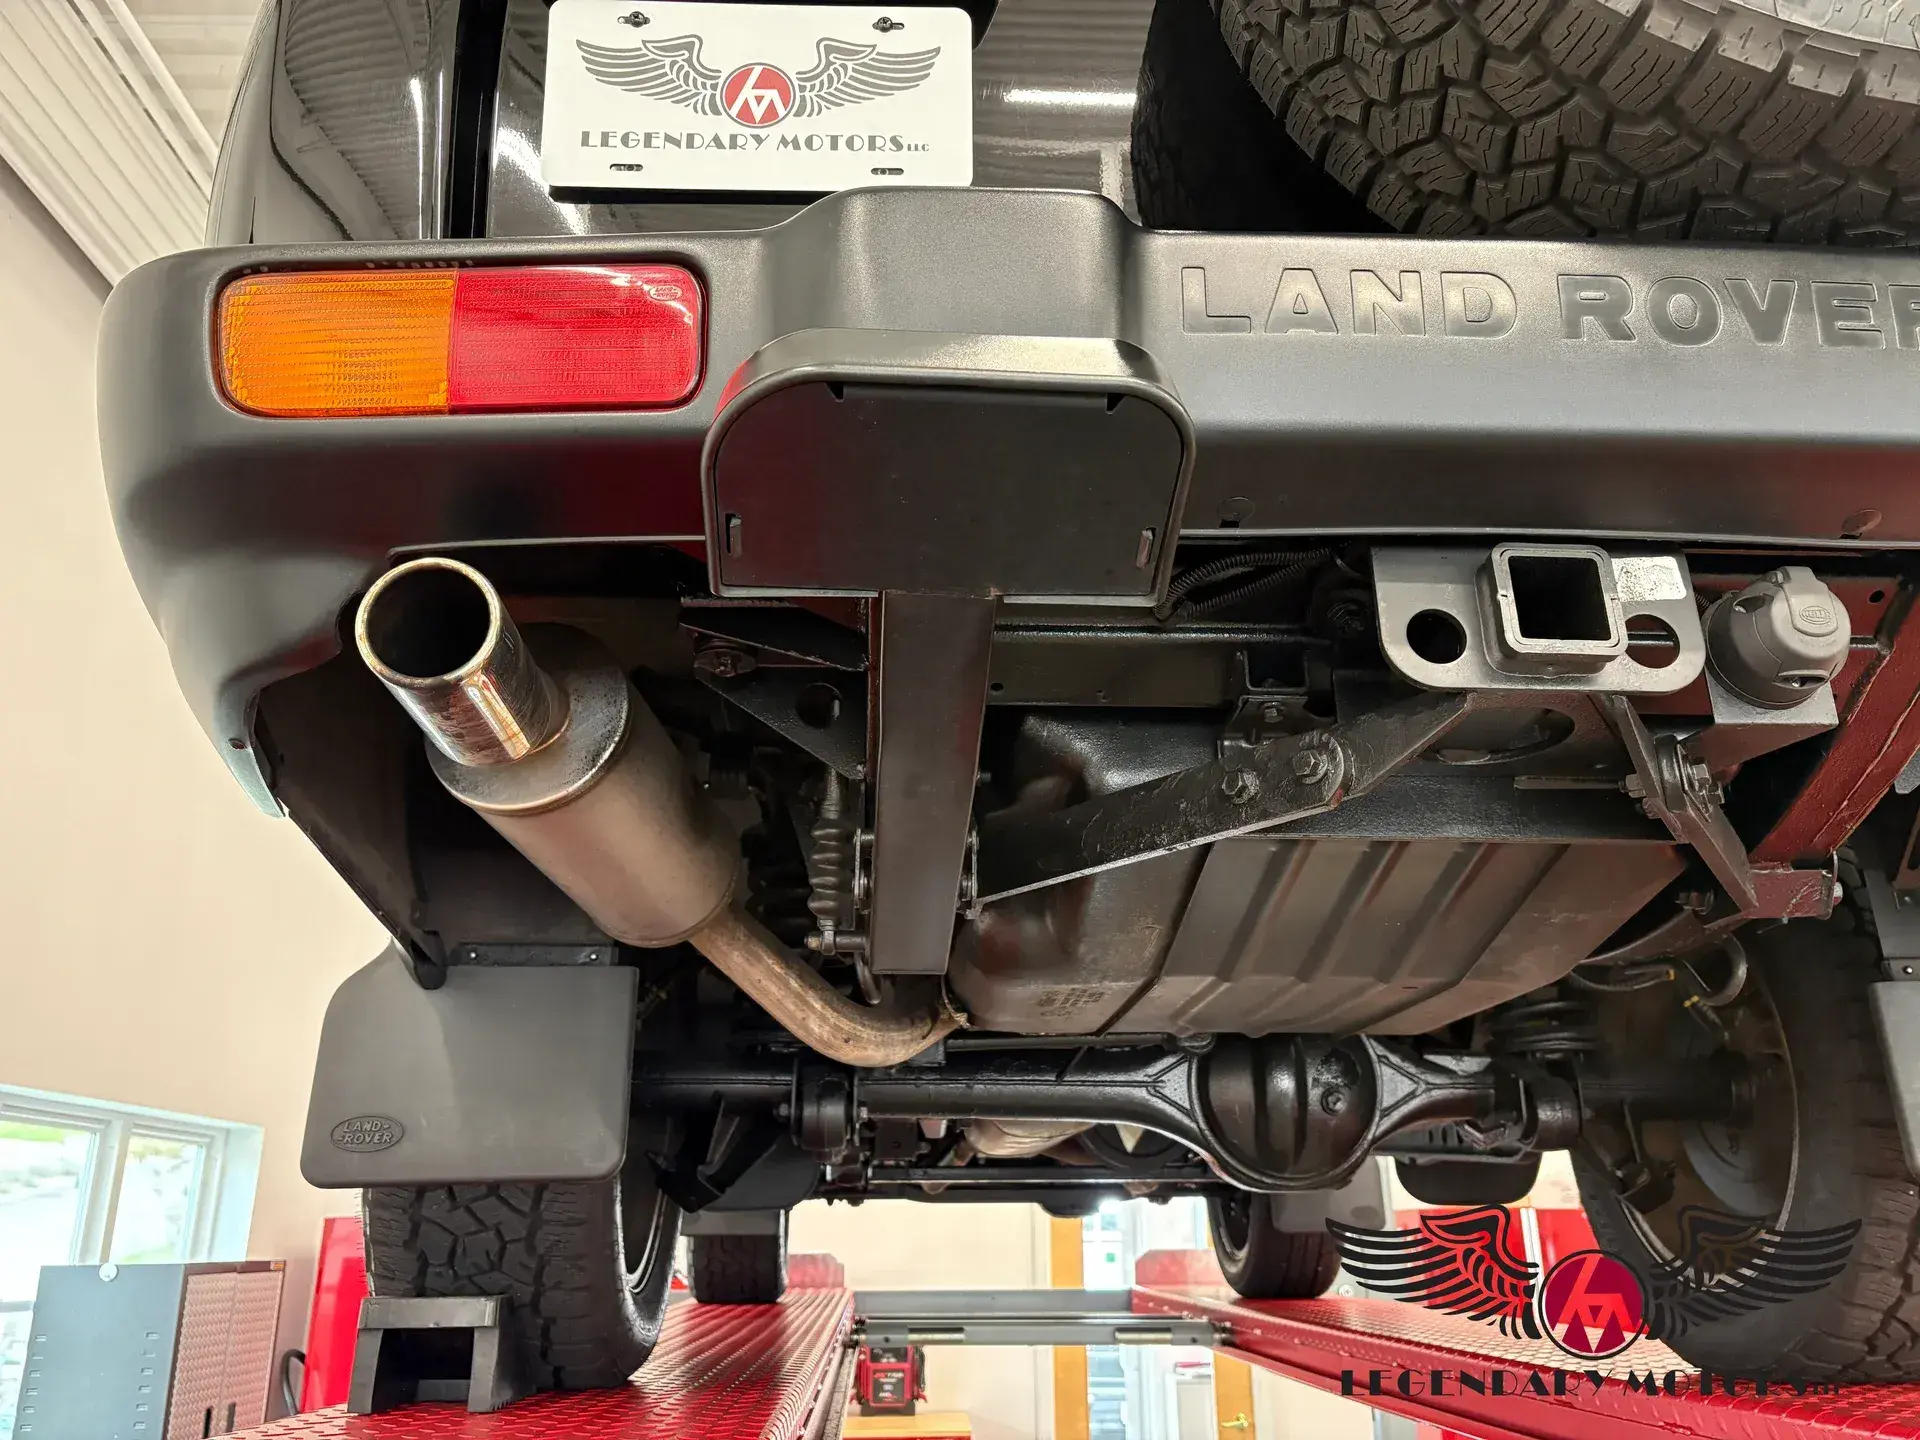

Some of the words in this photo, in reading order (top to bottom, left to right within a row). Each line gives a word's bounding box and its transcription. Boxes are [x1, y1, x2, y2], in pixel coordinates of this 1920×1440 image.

[580, 130, 771, 151] LEGENDARY
[776, 133, 904, 152] MOTORS
[906, 143, 930, 152] LLC
[1181, 266, 1518, 339] LAND
